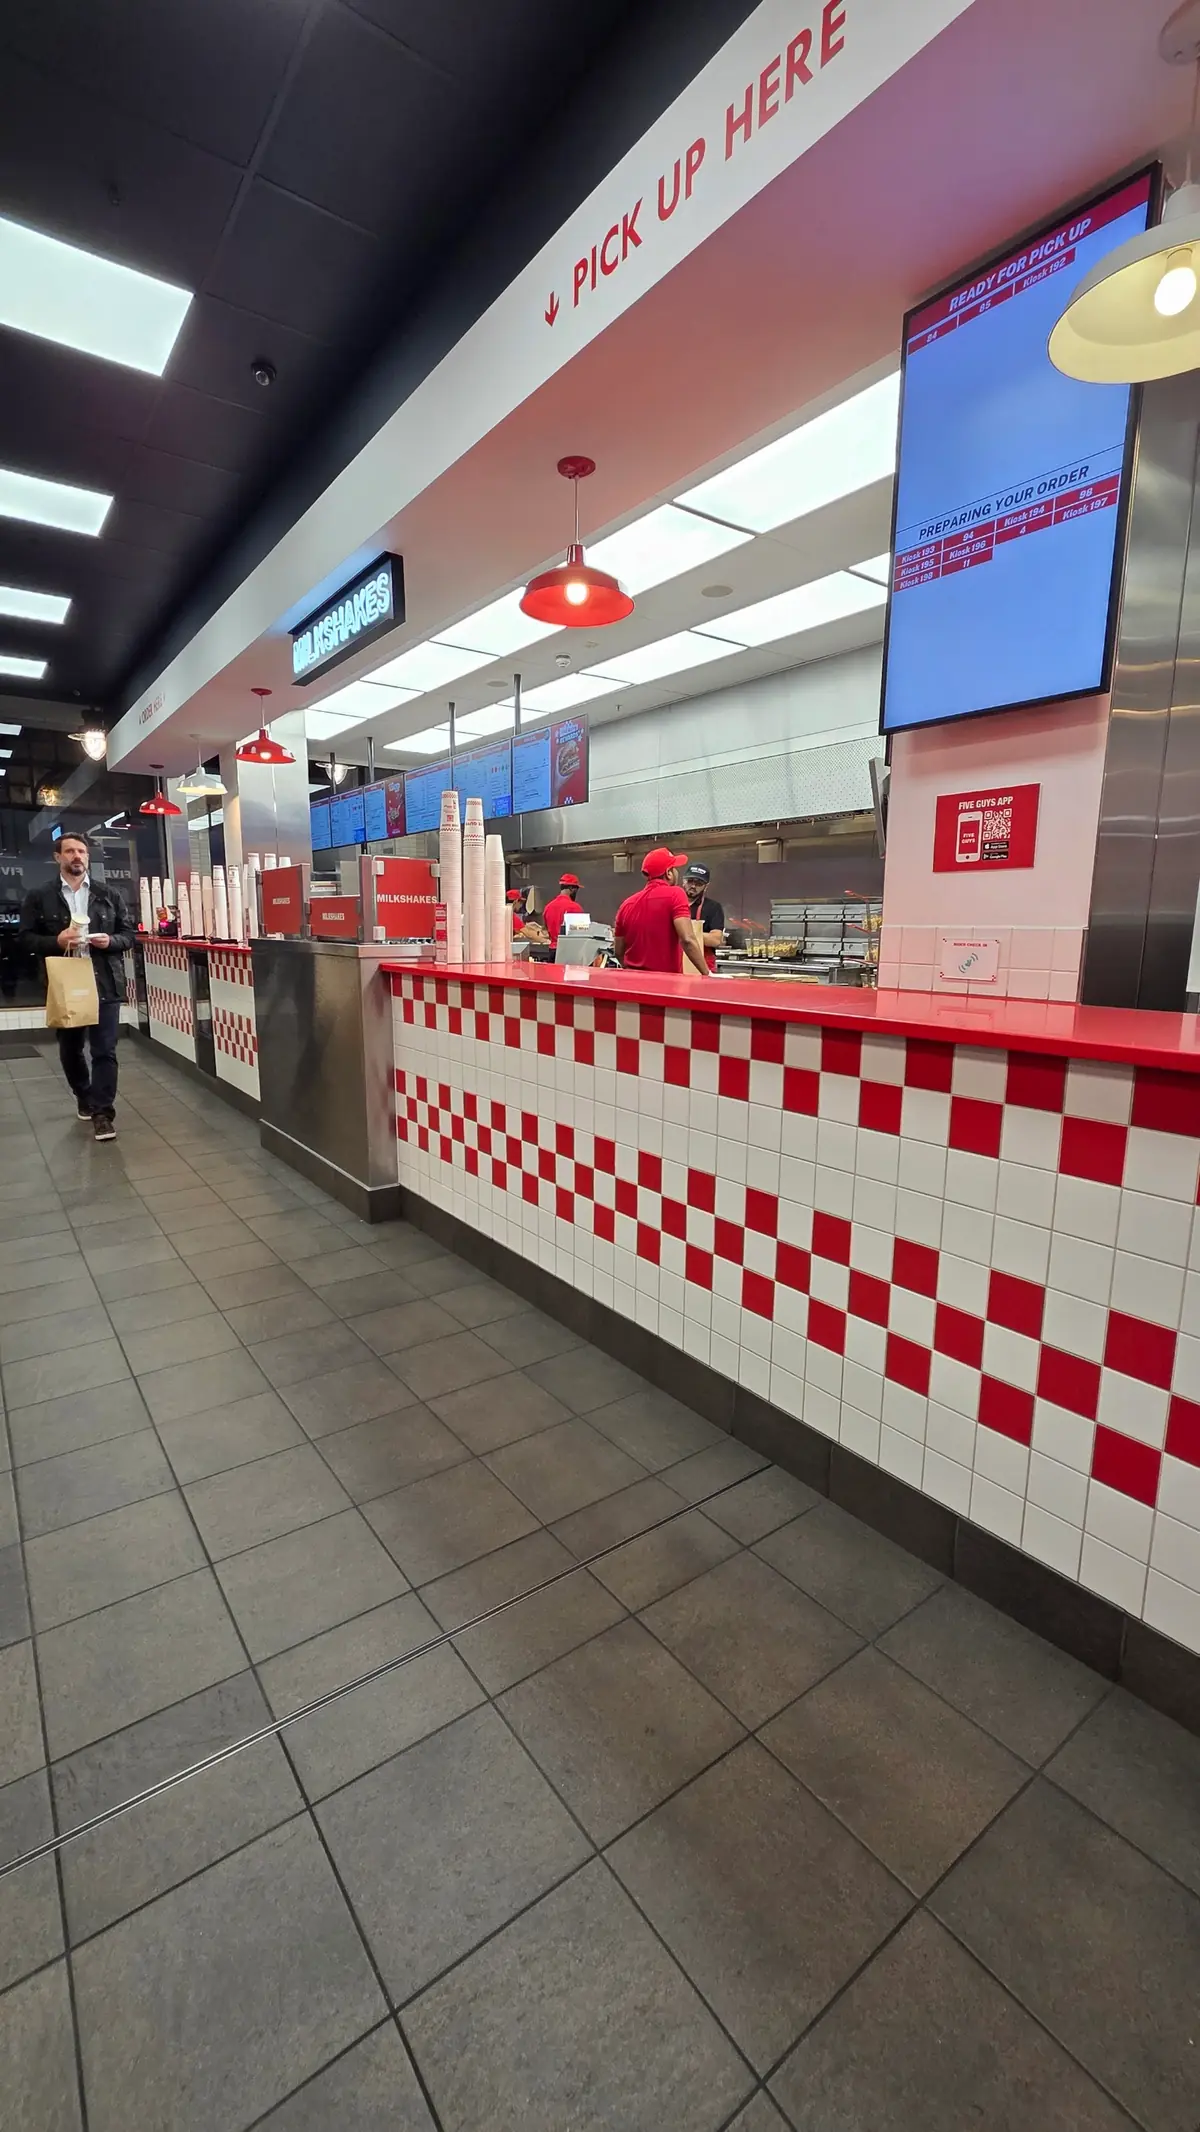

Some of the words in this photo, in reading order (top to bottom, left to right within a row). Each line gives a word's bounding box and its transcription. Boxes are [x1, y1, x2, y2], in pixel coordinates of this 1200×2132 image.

[573, 197, 644, 308] PICK
[657, 137, 706, 221] UP
[724, 0, 847, 161] HERE
[949, 274, 996, 312] READY
[997, 256, 1028, 283] FOR
[1029, 231, 1066, 265] PICK
[1068, 218, 1092, 241] UP
[1023, 267, 1049, 288] Kiosk
[1049, 256, 1067, 273] 192
[979, 299, 992, 313] 85
[1079, 487, 1093, 500] 98
[919, 503, 991, 540] PREPARING
[995, 486, 1034, 511] YOUR
[1036, 465, 1090, 495] ORDER
[1062, 504, 1088, 520] Kiosk
[1089, 497, 1108, 511] 197
[1003, 511, 1029, 527] Kiosk
[1029, 504, 1045, 518] 194
[962, 530, 975, 542] 94
[1019, 525, 1027, 535] 4
[901, 550, 921, 564] Kiosk
[921, 545, 936, 557] 193
[949, 545, 971, 560] Kiosk
[900, 564, 920, 577] Kiosk
[920, 558, 935, 570] 195
[962, 558, 971, 569] 11
[899, 577, 919, 590] Kiosk
[293, 572, 391, 674] MILKSHAKES
[958, 801, 975, 810] FIVE
[976, 798, 996, 808] GUYS
[997, 796, 1014, 806] APP
[377, 894, 437, 904] MILKSHAKES
